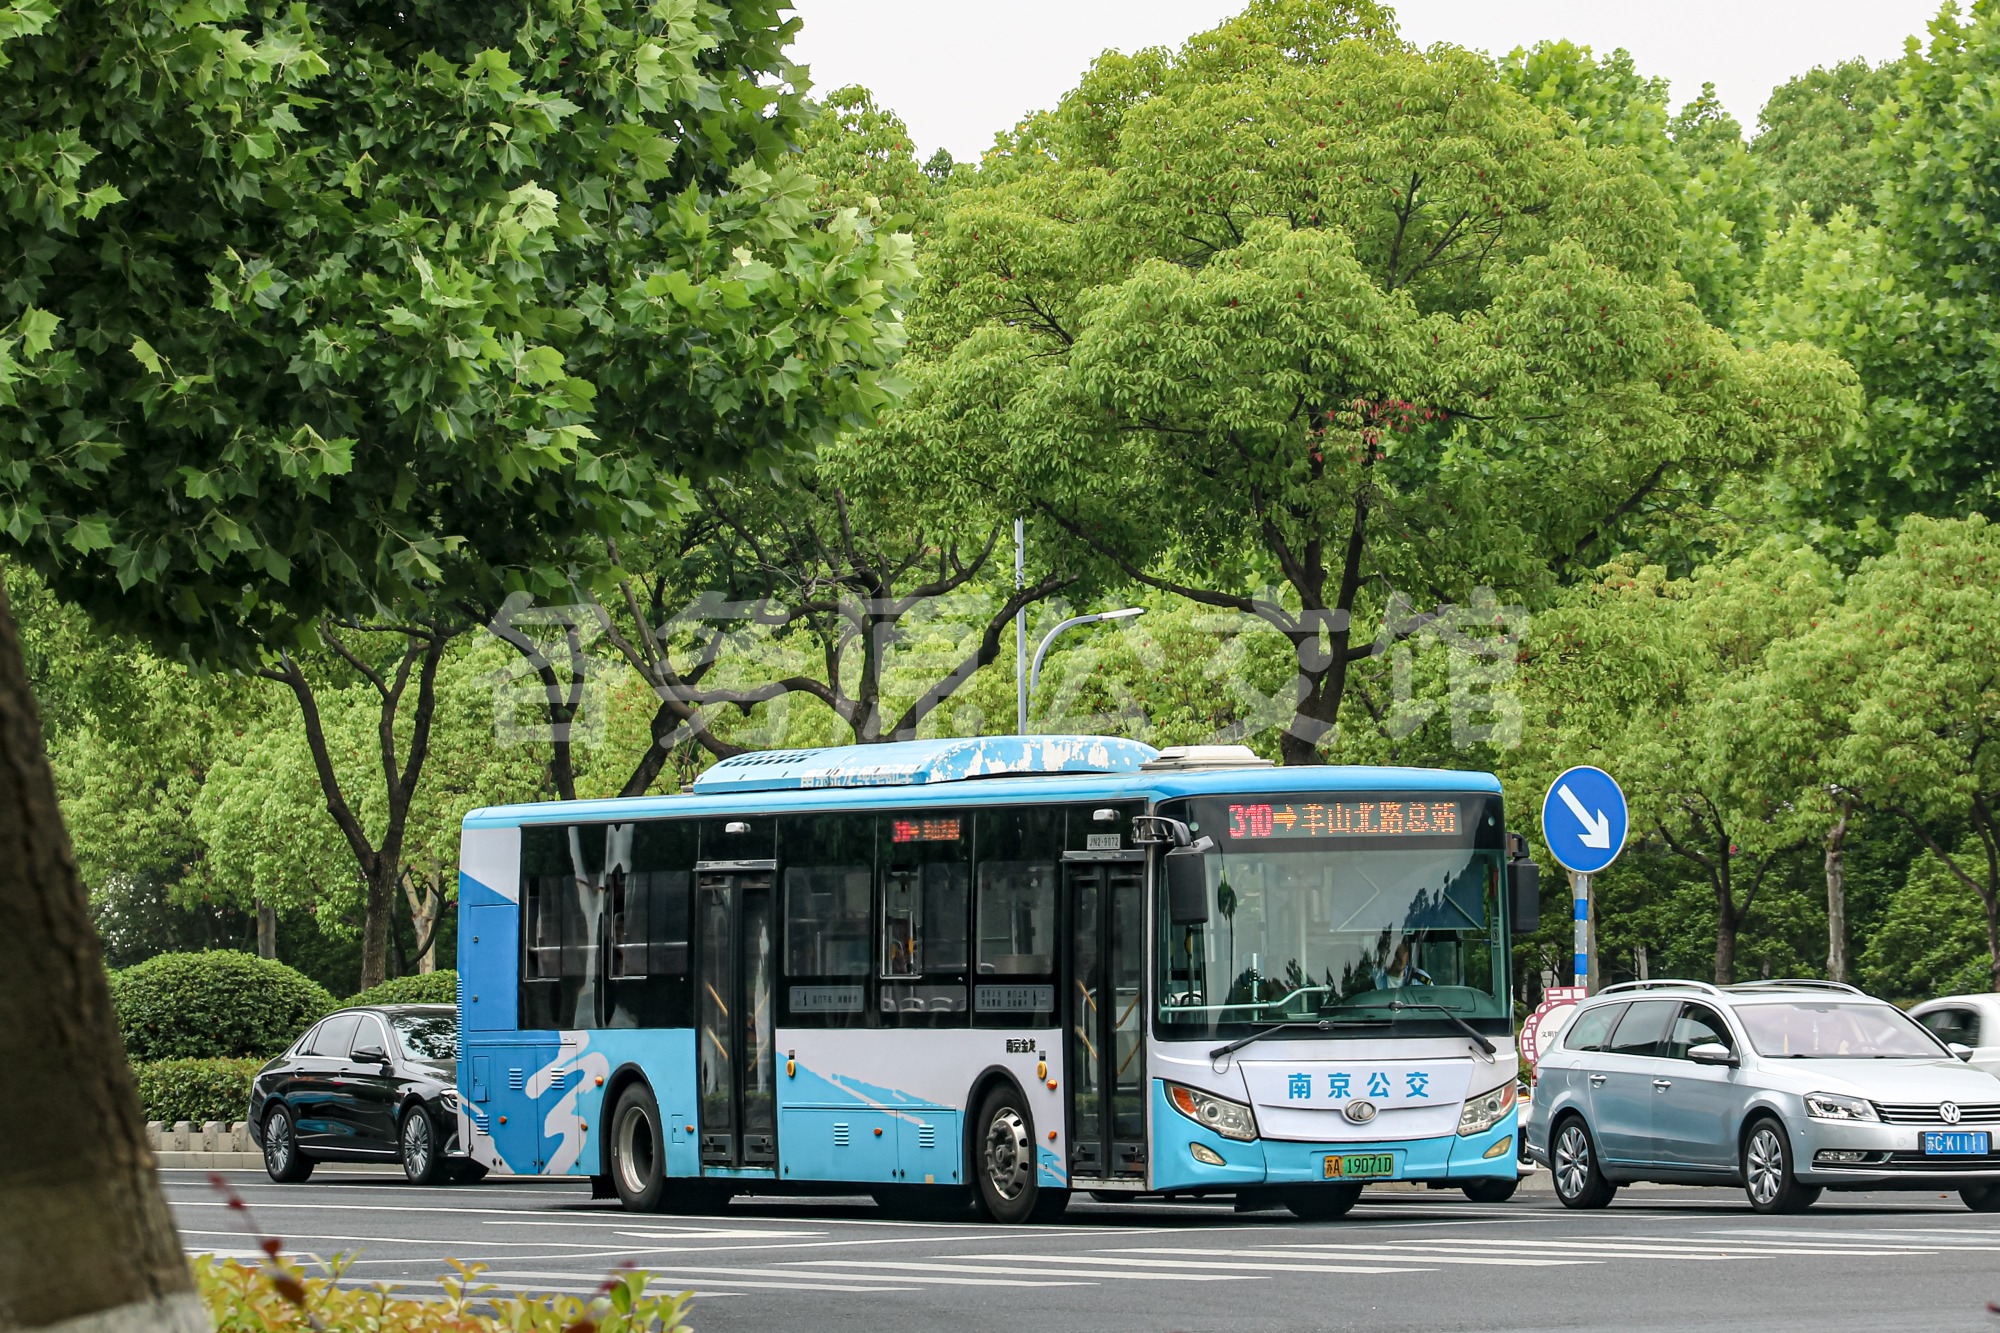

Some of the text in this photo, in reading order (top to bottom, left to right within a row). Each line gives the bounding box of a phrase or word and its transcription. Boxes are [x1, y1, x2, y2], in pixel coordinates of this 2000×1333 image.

[1228, 801, 1457, 837] 310 羊山北路总站
[1006, 1038, 1036, 1053] 南京金龙
[1288, 1072, 1429, 1099] 南京公交
